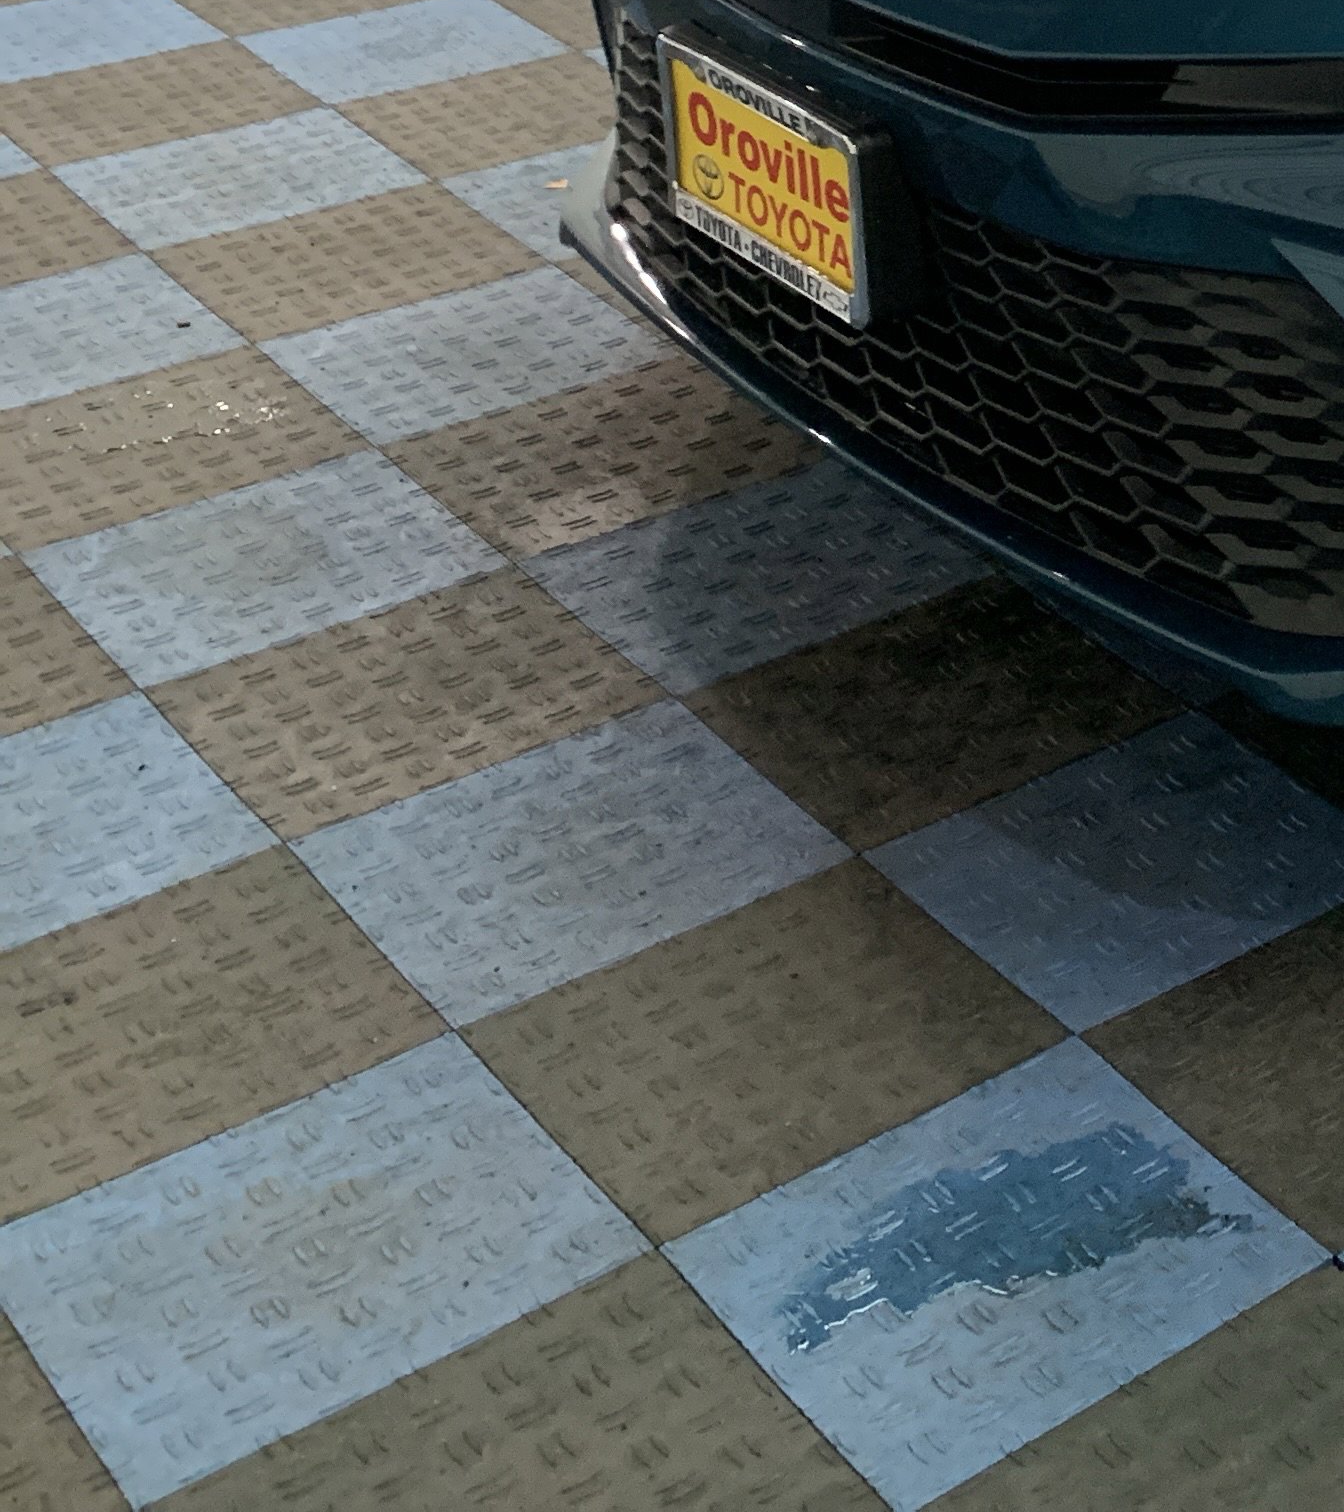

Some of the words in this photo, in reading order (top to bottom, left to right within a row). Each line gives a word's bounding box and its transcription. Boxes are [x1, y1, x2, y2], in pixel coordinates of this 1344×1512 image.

[707, 68, 802, 133] OROVILLE
[687, 91, 850, 224] Oroville
[695, 204, 742, 252] TOYOTA
[749, 240, 822, 302] CHEVROLET
[728, 172, 853, 279] TOYOTA
